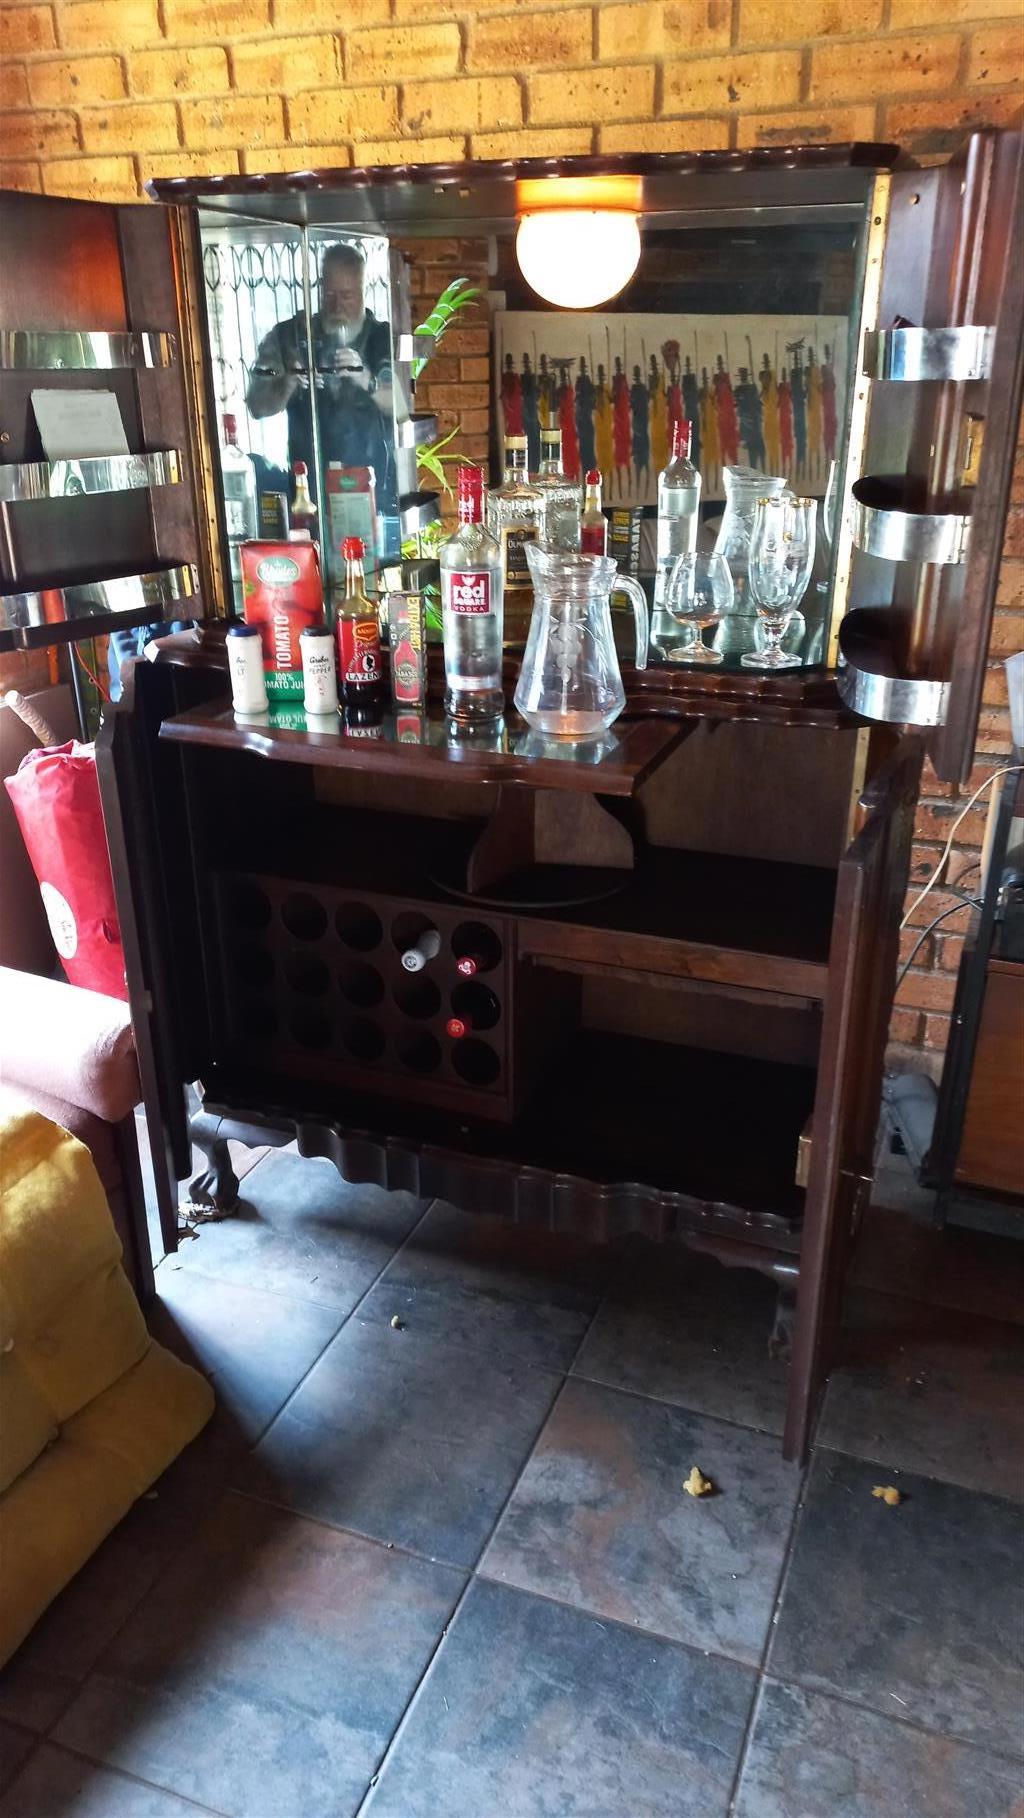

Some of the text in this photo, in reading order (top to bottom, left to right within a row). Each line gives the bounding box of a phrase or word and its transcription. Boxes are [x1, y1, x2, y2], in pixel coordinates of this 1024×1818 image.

[453, 579, 485, 599] red
[273, 616, 292, 669] TOMATO
[275, 672, 295, 682] 100%
